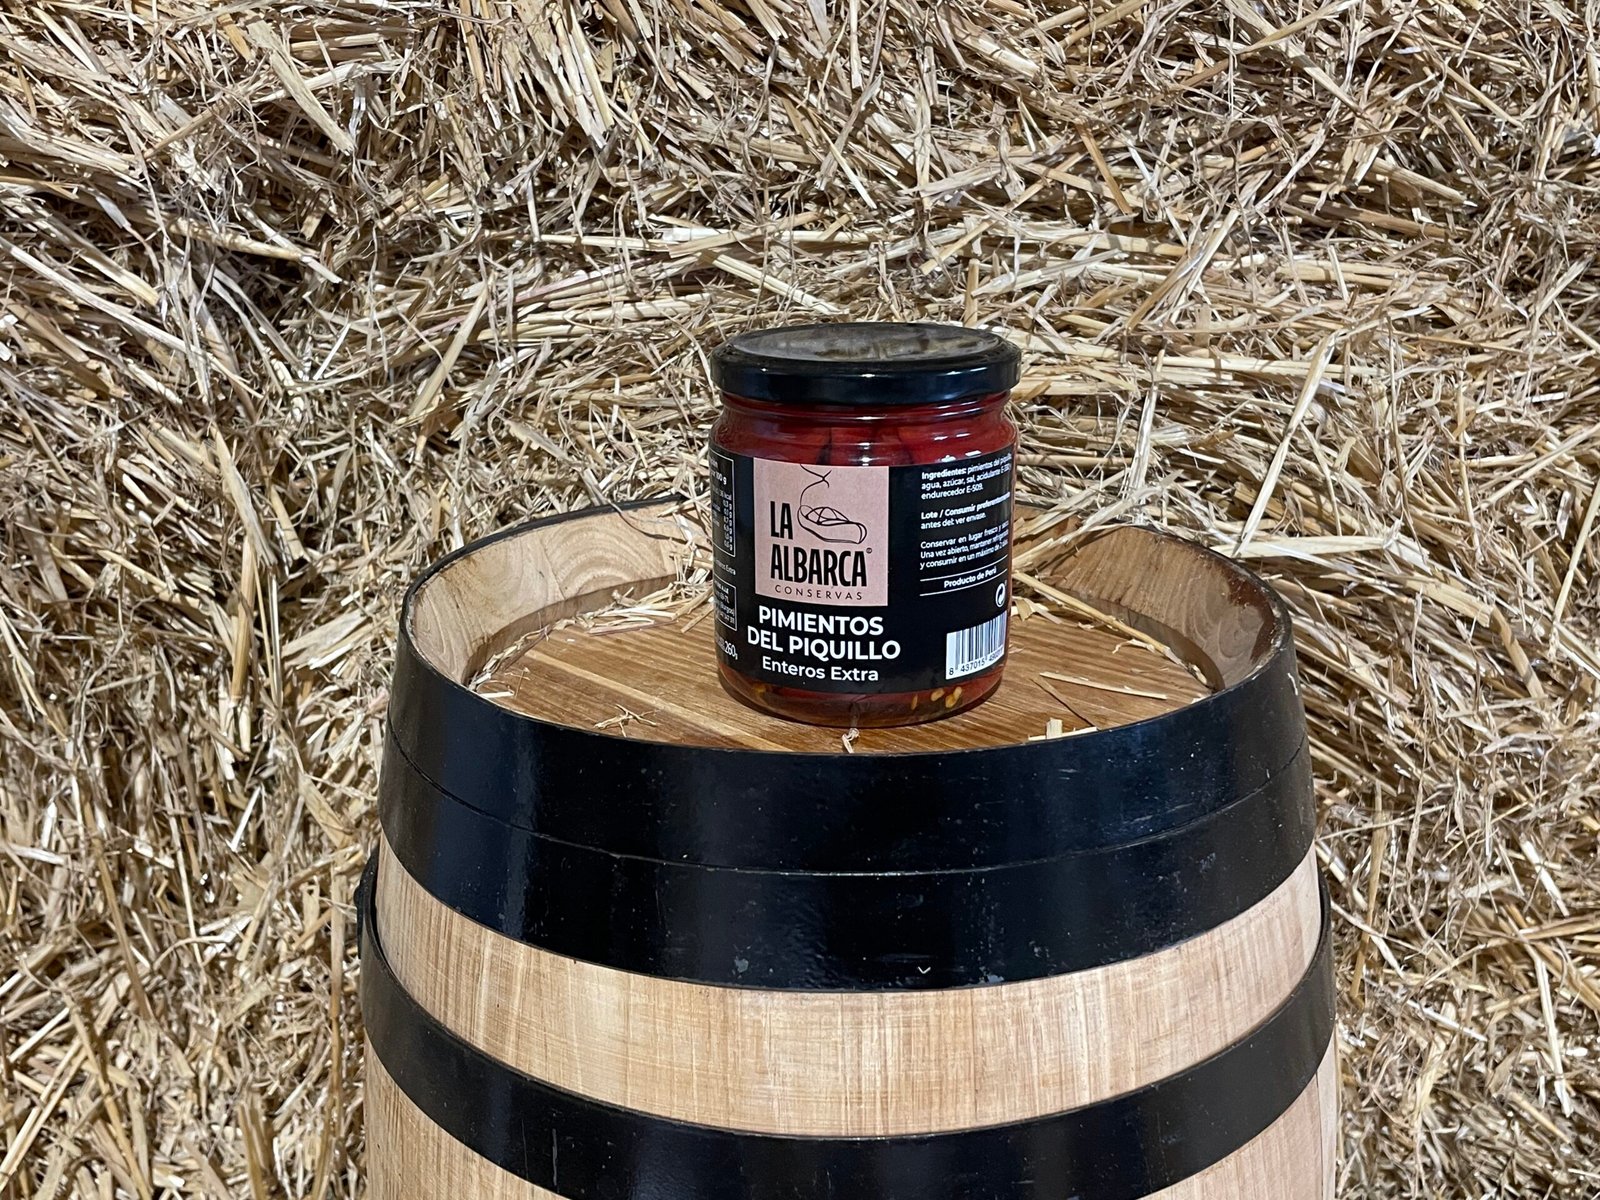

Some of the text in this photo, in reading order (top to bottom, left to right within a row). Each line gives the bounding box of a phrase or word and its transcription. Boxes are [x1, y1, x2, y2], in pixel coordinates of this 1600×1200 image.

[922, 468, 967, 480] Ingredientes:
[967, 462, 993, 474] pimientos
[921, 482, 941, 491] agua,
[942, 478, 966, 488] azúcar,
[966, 475, 976, 483] sal,
[921, 487, 965, 500] endurecedor
[770, 501, 793, 540] LA
[921, 511, 938, 520] Lote
[939, 510, 944, 518] /
[945, 504, 976, 517] Consumir
[921, 521, 941, 530] antes
[921, 538, 956, 549] Conservar
[968, 532, 983, 542] lugar
[984, 527, 998, 537] fresco
[920, 550, 935, 559] Una
[935, 549, 947, 557] vez
[947, 546, 969, 556] abierto,
[970, 539, 992, 550] mantener
[771, 544, 867, 587] ALBARCA
[920, 562, 925, 570] y
[926, 556, 958, 569] consumir
[958, 555, 967, 563] en
[967, 553, 975, 561] un
[944, 566, 997, 588] Producto de Perú
[775, 584, 863, 600] CONSERVAS
[758, 605, 884, 636] PIMIENTOS
[748, 625, 783, 652] DEL
[789, 636, 901, 662] PIQUILLO
[762, 656, 879, 681] Enteros Extra
[949, 668, 954, 676] 8
